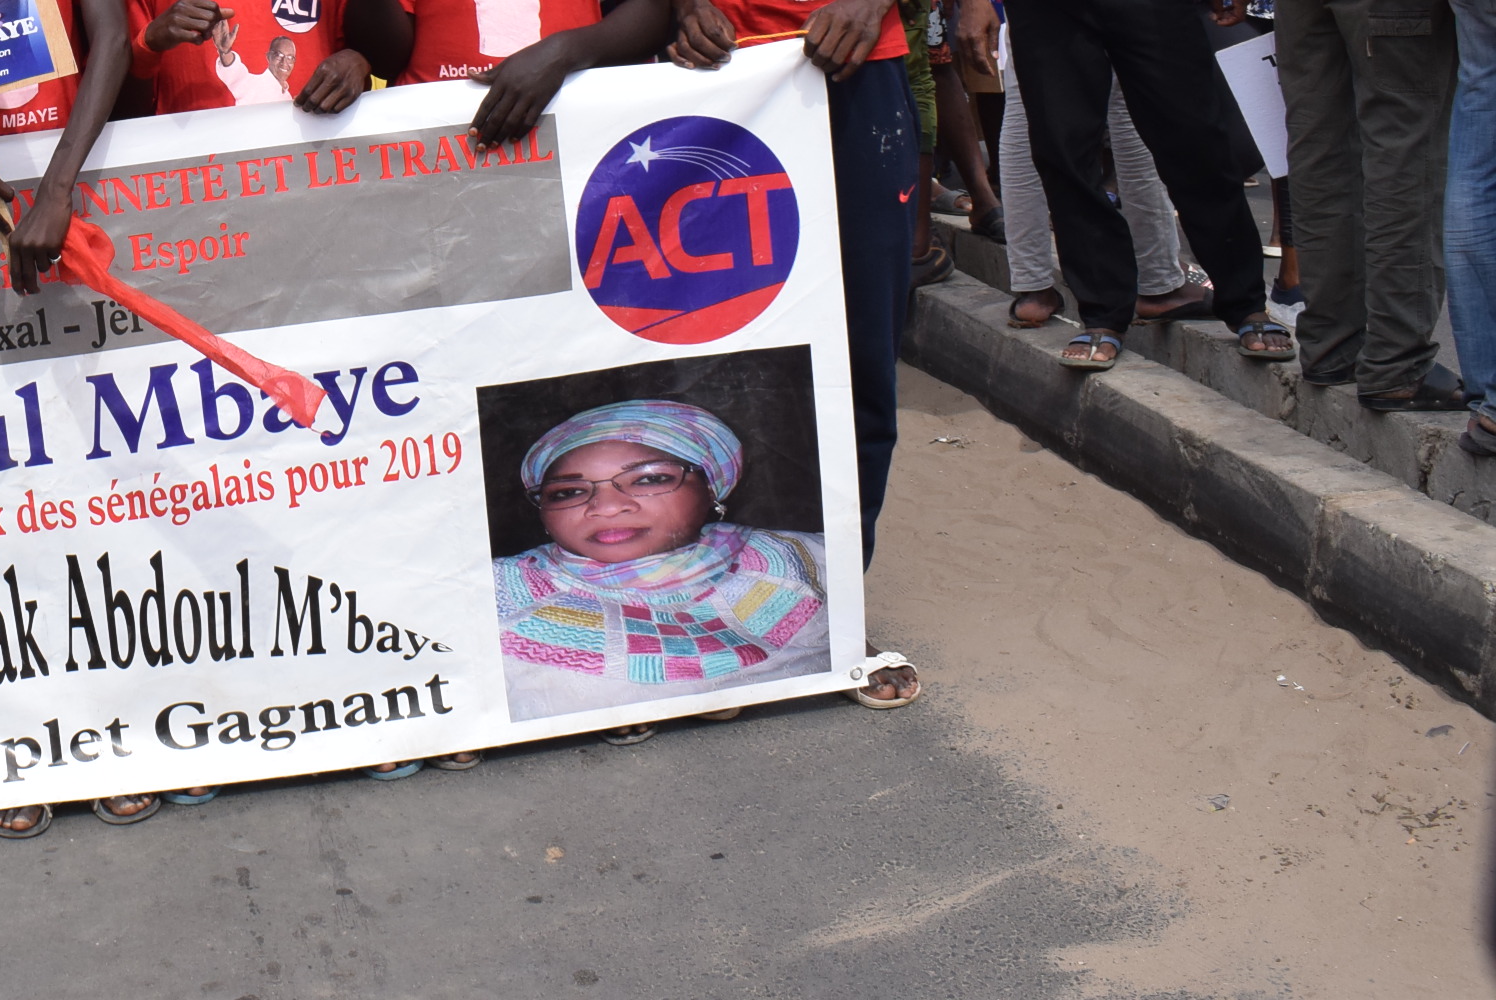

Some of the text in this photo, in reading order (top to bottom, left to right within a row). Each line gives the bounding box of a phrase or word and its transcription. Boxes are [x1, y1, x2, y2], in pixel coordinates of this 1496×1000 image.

[2, 106, 58, 128] MBAYE
[236, 155, 293, 198] ET
[304, 146, 361, 190] LE
[368, 125, 554, 181] TRAVAIL
[127, 222, 251, 276] Espoir
[583, 171, 793, 290] ACT
[85, 357, 421, 447] Mbaye
[16, 489, 78, 534] des
[88, 458, 276, 527] sénégalais
[284, 454, 370, 509] pour
[378, 431, 464, 484] 2019
[64, 549, 255, 673] Abdoul
[154, 672, 455, 753] Gagnant
